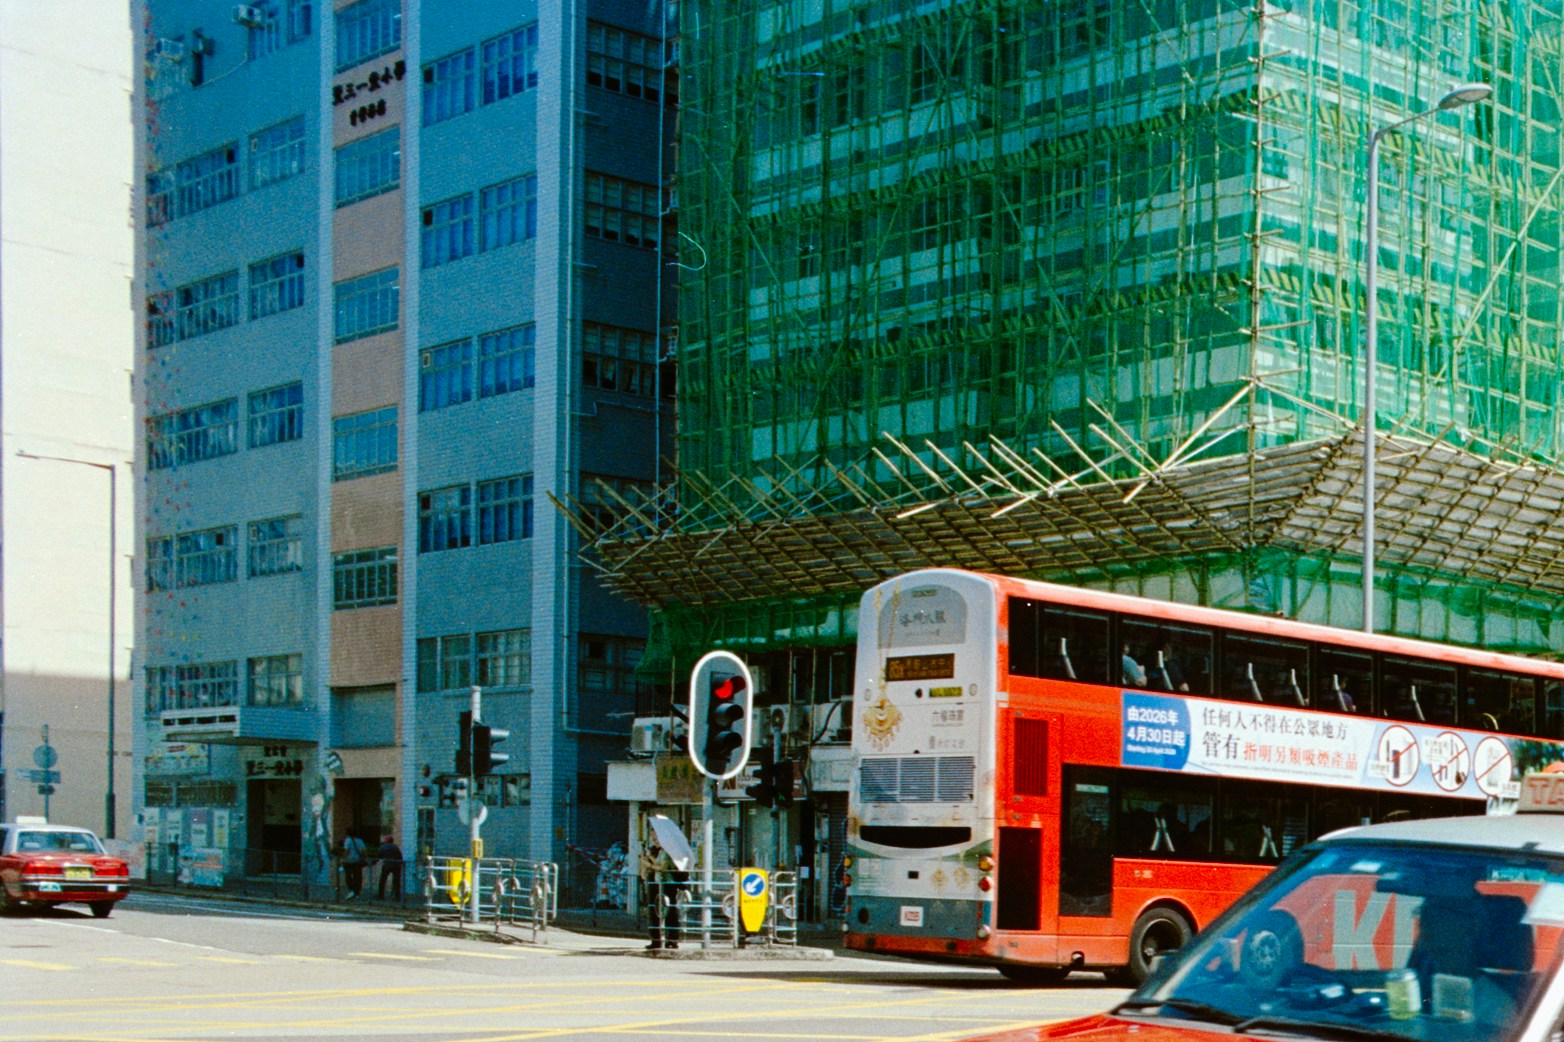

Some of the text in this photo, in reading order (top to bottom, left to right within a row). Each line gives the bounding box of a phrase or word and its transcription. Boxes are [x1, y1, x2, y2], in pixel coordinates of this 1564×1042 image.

[1127, 705, 1179, 726] 由2026年
[1202, 706, 1349, 741] 任何人不得在公眾地方
[1126, 726, 1186, 747] 4月30日起
[1201, 731, 1240, 760] 管有
